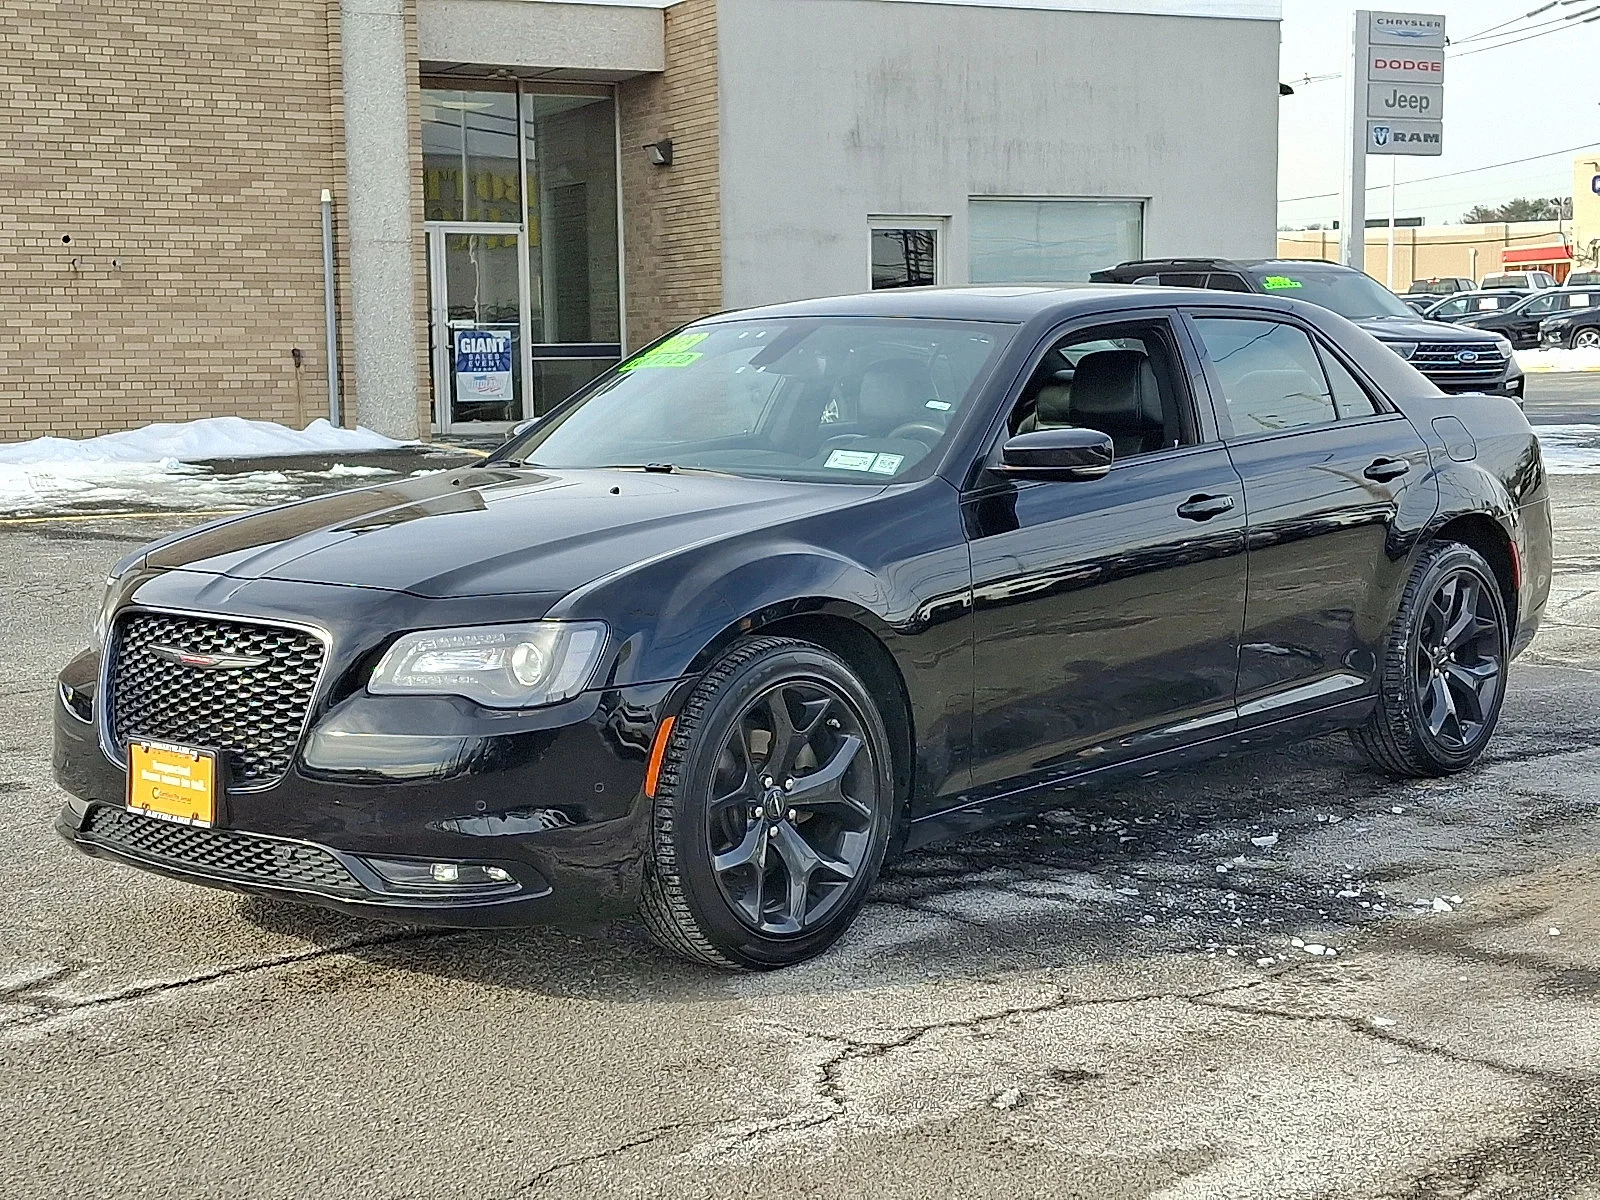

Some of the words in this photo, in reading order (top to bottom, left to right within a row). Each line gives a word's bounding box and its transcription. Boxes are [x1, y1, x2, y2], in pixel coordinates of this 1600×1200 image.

[1376, 18, 1441, 28] CHRYSLER
[1374, 59, 1441, 72] DODGE
[1384, 89, 1430, 113] Jeep
[1393, 132, 1440, 143] RAM
[460, 337, 506, 353] GIANT
